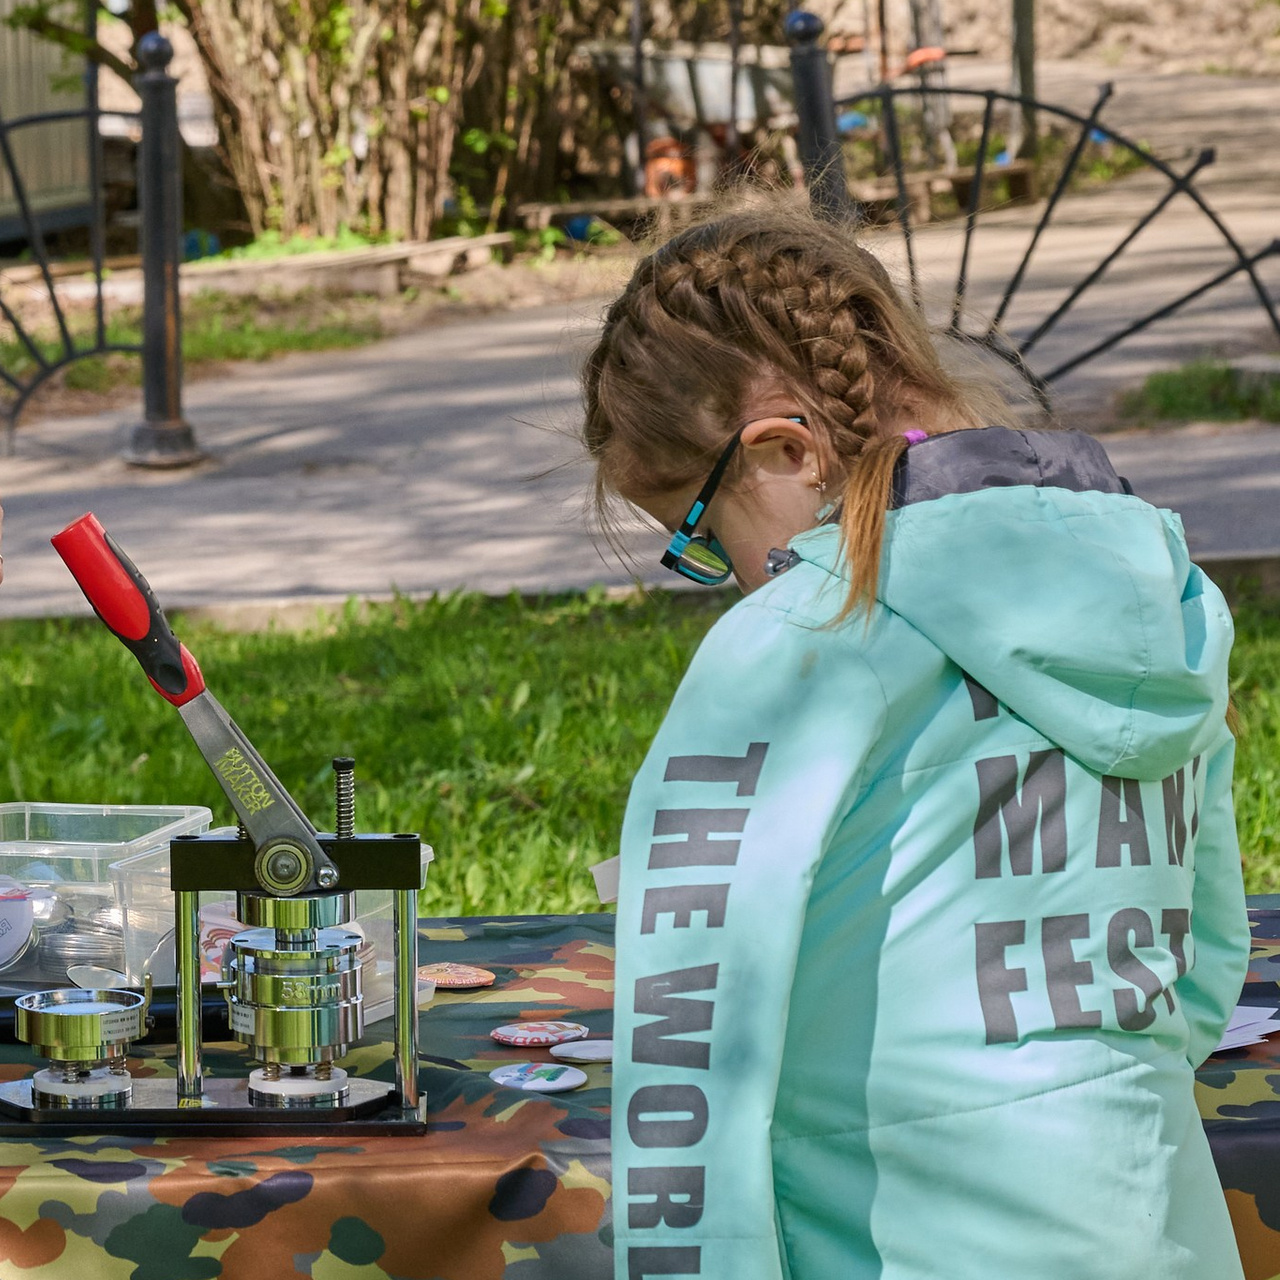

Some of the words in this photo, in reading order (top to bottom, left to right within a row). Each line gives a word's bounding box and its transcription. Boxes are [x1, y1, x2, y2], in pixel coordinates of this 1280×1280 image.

[213, 756, 262, 816] MAKER
[225, 746, 276, 809] BUTTON
[640, 742, 770, 935] THE
[974, 906, 1196, 1047] FEST
